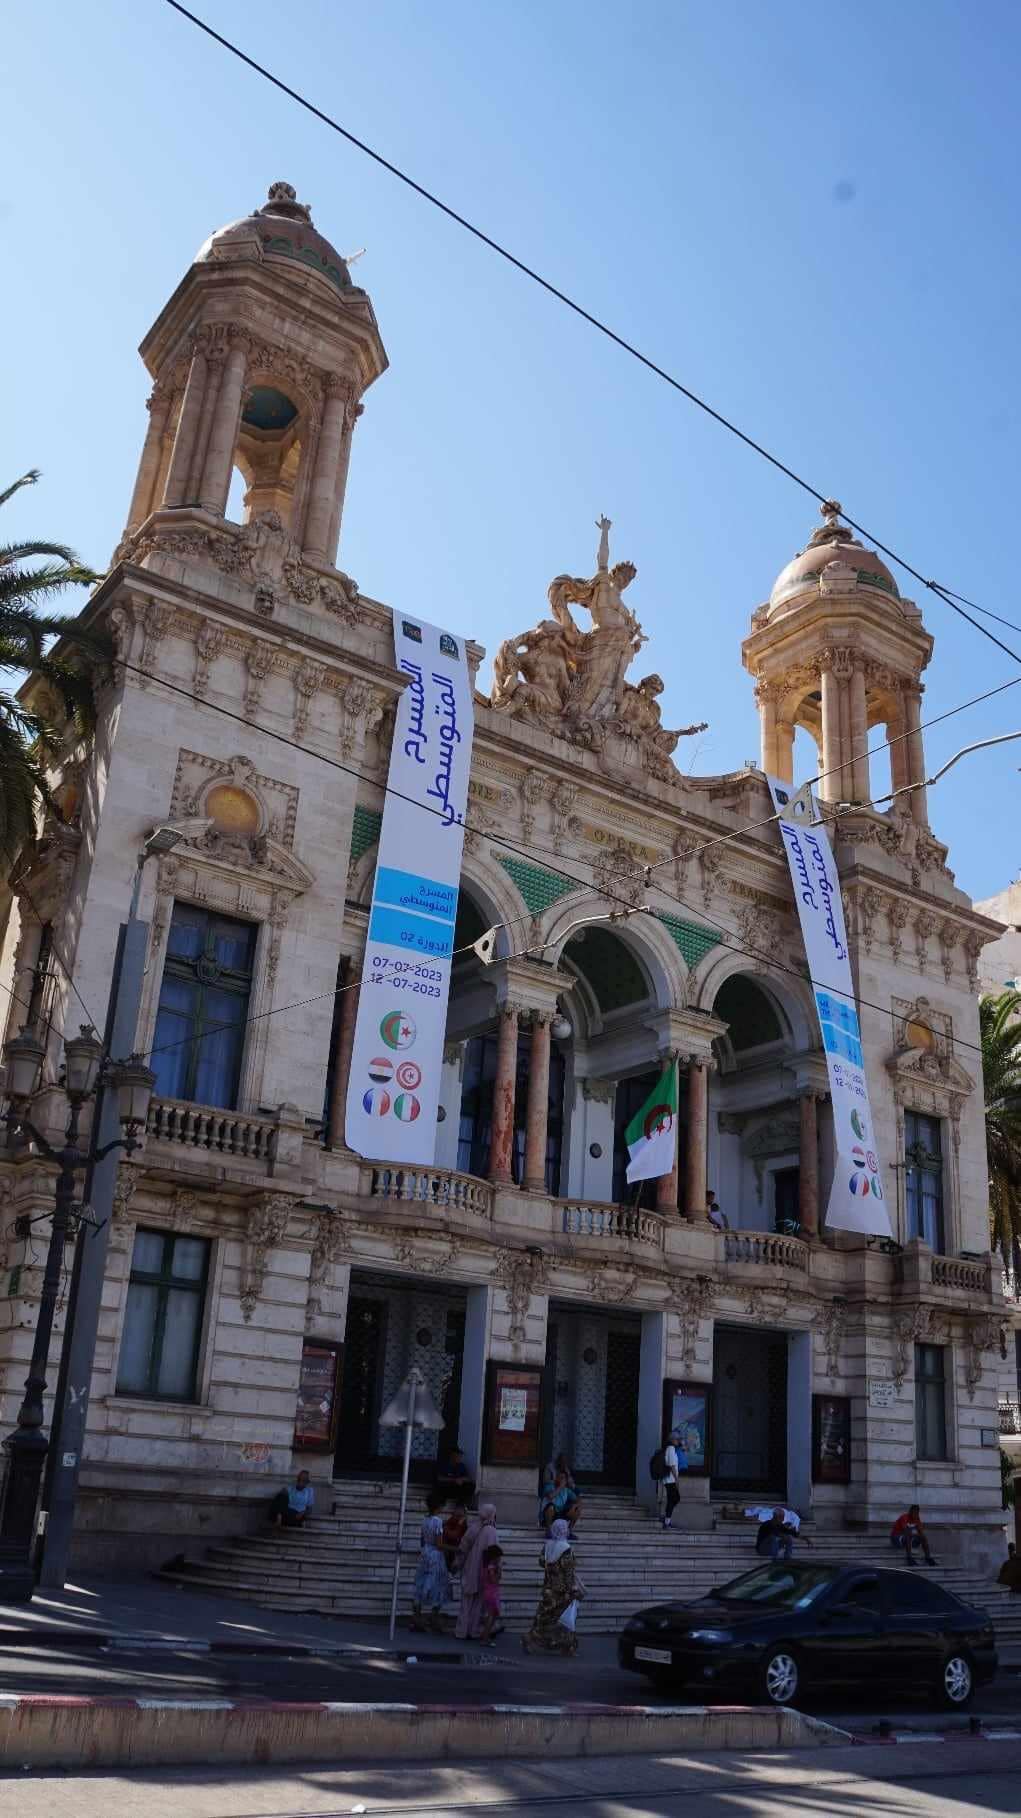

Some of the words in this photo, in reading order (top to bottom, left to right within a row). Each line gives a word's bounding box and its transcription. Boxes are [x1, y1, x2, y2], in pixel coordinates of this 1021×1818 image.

[400, 659, 428, 764] المسرح
[427, 672, 463, 827] المتوسطي
[780, 824, 819, 910] المسرح
[803, 833, 848, 960] المتوسطي
[372, 956, 443, 982] 07-07-2023
